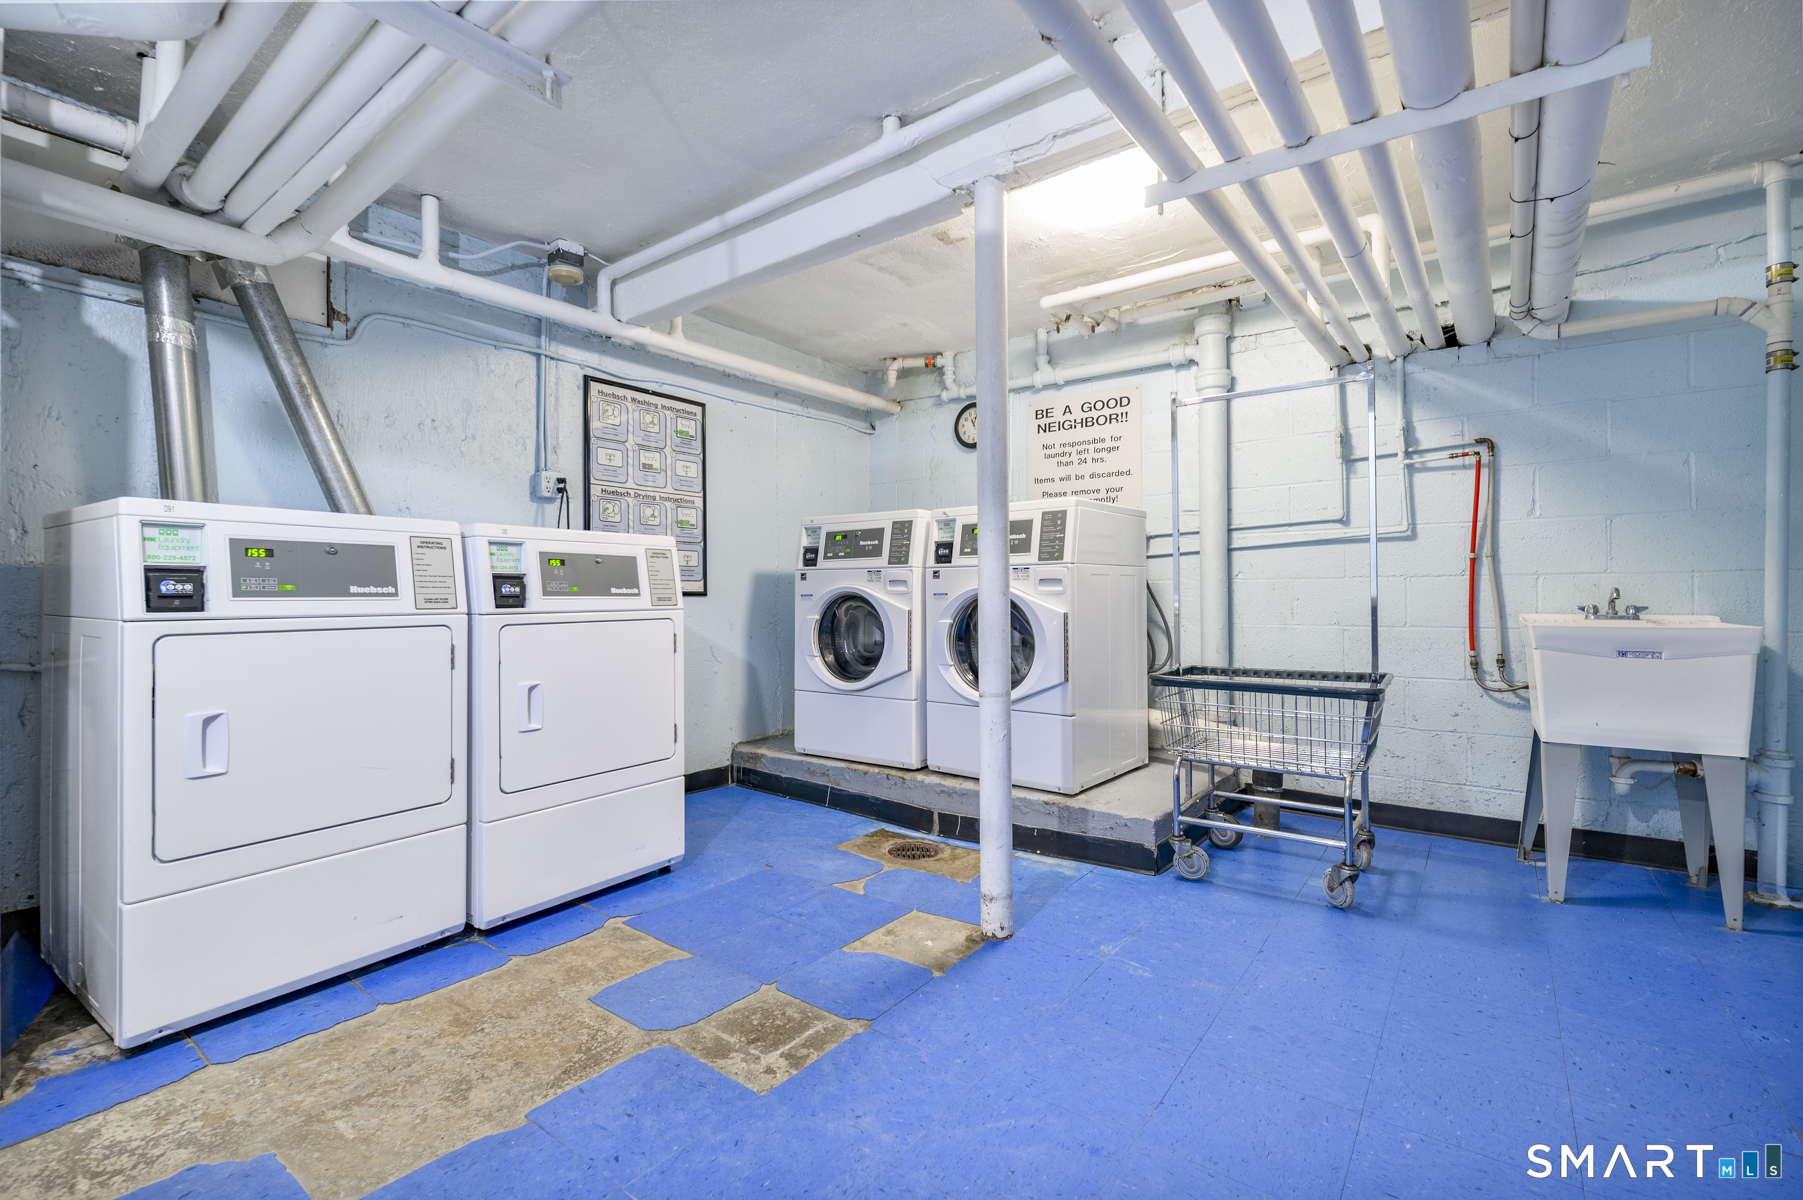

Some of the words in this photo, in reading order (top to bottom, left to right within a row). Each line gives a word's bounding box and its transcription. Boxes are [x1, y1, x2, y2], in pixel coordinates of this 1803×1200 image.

[598, 389, 628, 401] Huebsch
[631, 397, 658, 409] Washing
[661, 404, 697, 417] Instructions
[1035, 407, 1054, 420] BE
[1062, 405, 1073, 416] A
[1081, 396, 1131, 413] GOOD
[1037, 411, 1128, 434] NEIGHBOR!!
[1042, 443, 1056, 451] Not
[1059, 437, 1106, 448] responsible
[1044, 450, 1072, 459] laundry
[1076, 448, 1090, 456] left
[1093, 445, 1120, 454] longer
[1077, 457, 1087, 465] 24
[1059, 474, 1071, 482] will
[1089, 469, 1133, 479] discarded.
[601, 488, 631, 498] Huebsch
[634, 492, 656, 501] Drying
[659, 495, 695, 505] Instructions
[1042, 490, 1068, 498] Please
[1071, 488, 1101, 496] remove
[1105, 485, 1123, 494] your
[164, 505, 175, 513] D91
[158, 536, 191, 545] Laundry
[158, 543, 200, 552] Equipment
